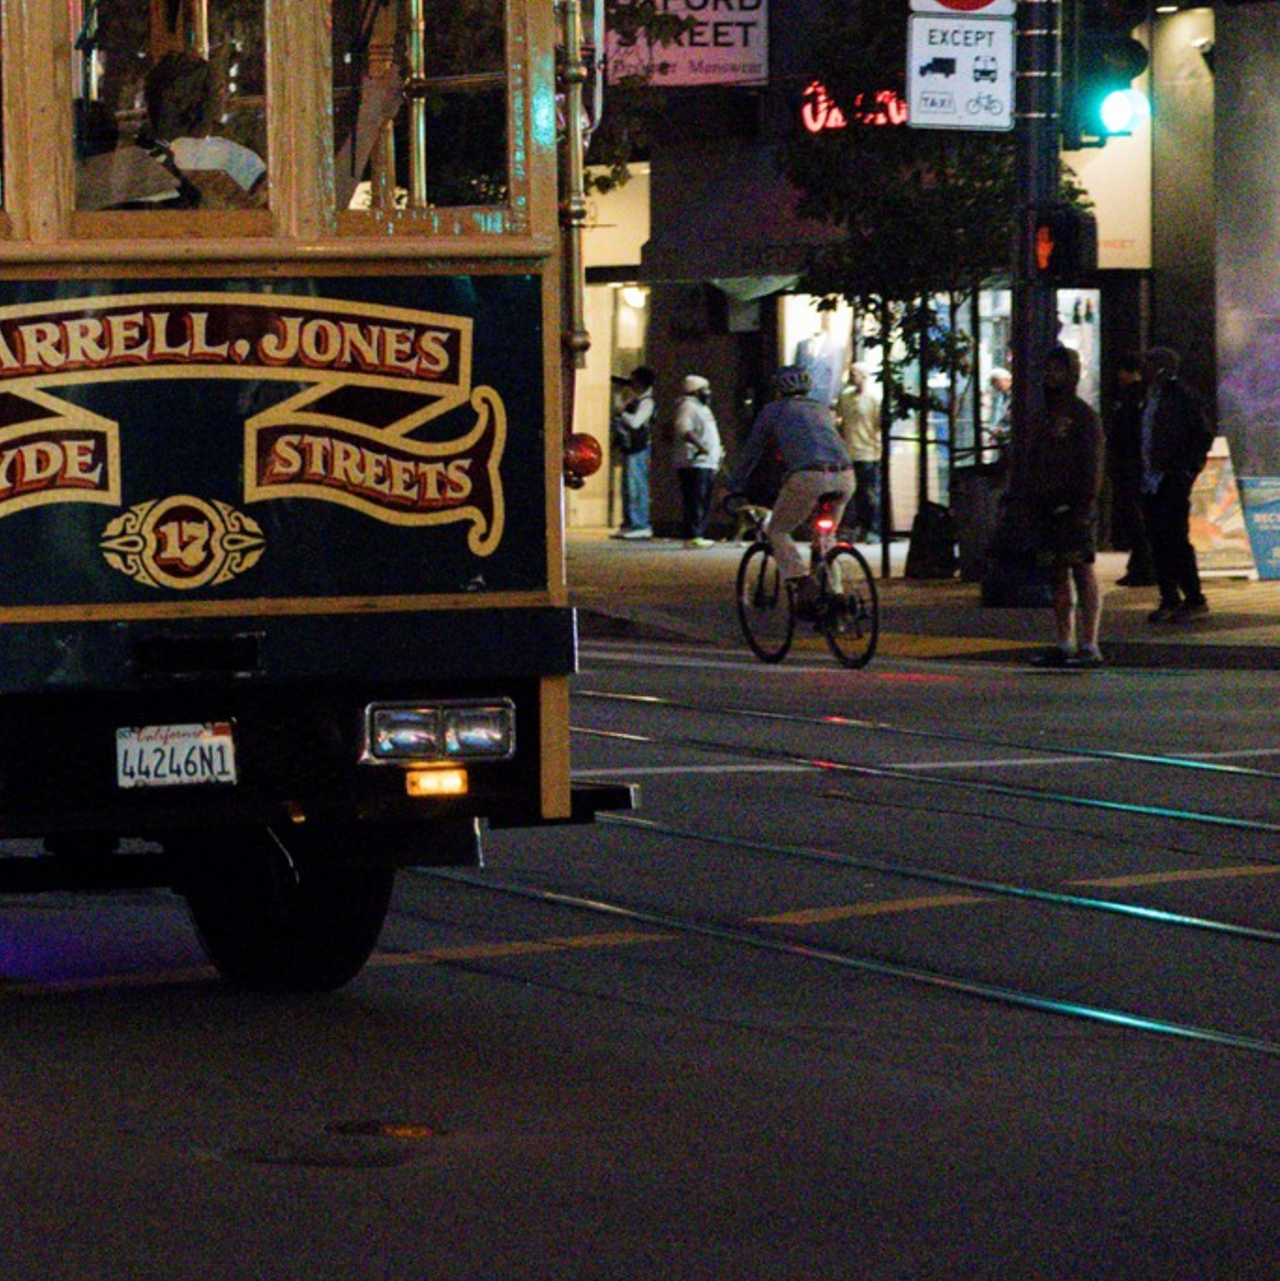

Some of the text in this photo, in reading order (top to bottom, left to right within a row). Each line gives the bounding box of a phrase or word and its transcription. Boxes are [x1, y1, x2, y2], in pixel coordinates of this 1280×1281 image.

[928, 28, 995, 47] EXCEPT
[922, 97, 952, 109] TAXI
[260, 317, 451, 379] JONES
[270, 433, 474, 503] STREETS
[158, 519, 211, 573] 17
[136, 726, 205, 745] California
[122, 744, 231, 780] 44246N1
